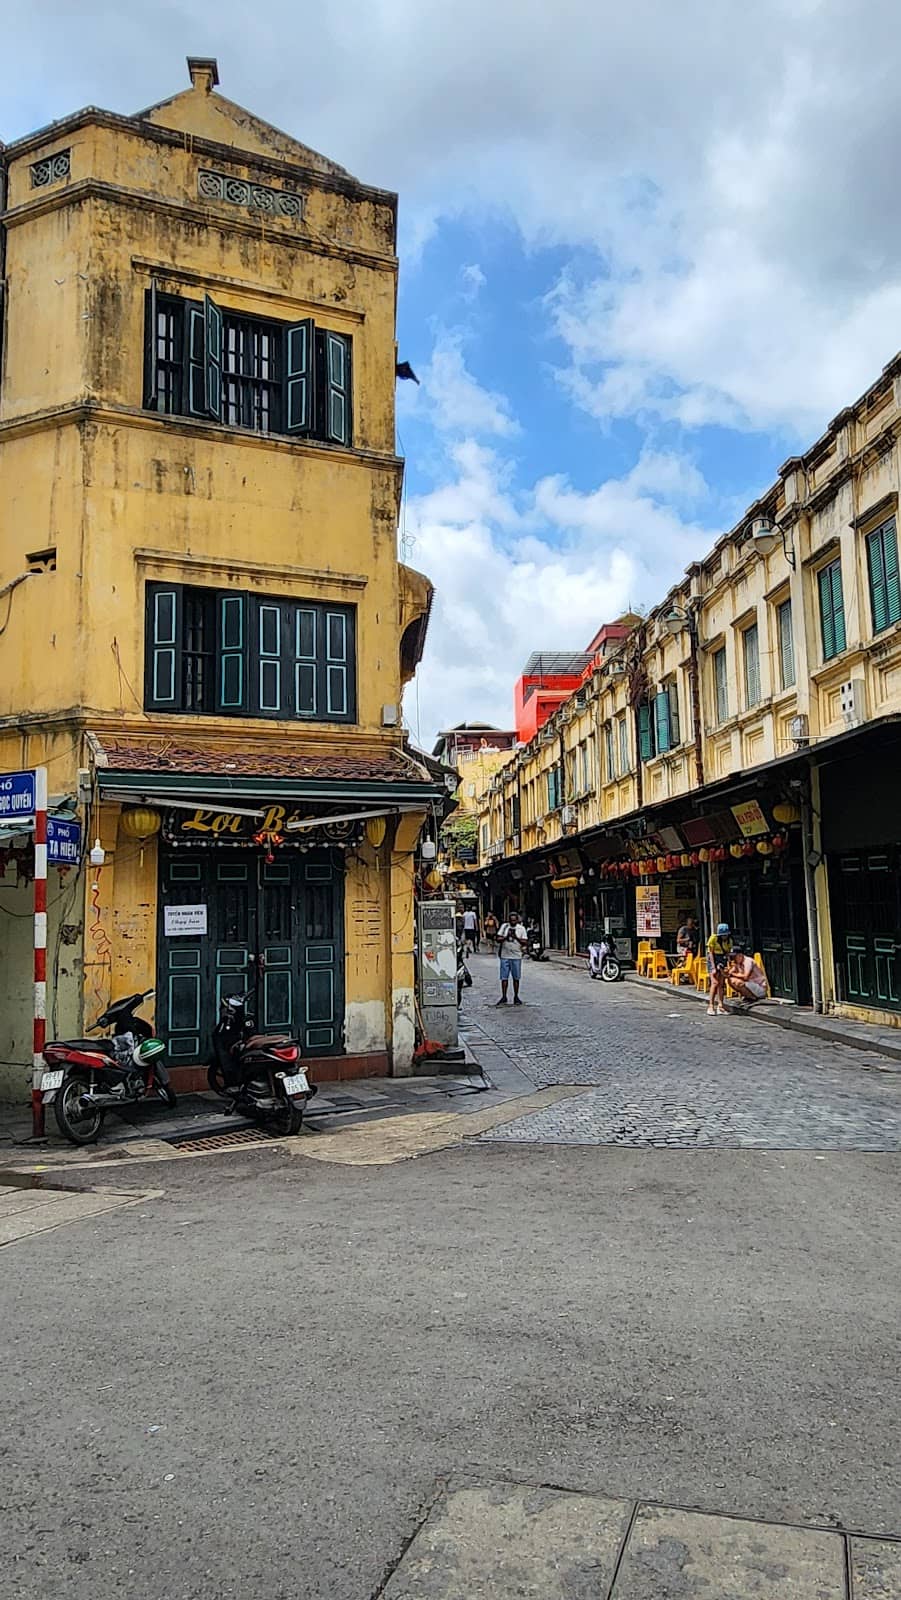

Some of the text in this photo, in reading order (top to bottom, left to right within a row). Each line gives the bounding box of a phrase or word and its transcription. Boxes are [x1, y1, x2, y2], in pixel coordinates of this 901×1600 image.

[0, 777, 13, 790] HỐ
[57, 827, 70, 837] PHỐ
[49, 839, 59, 858] TẠ
